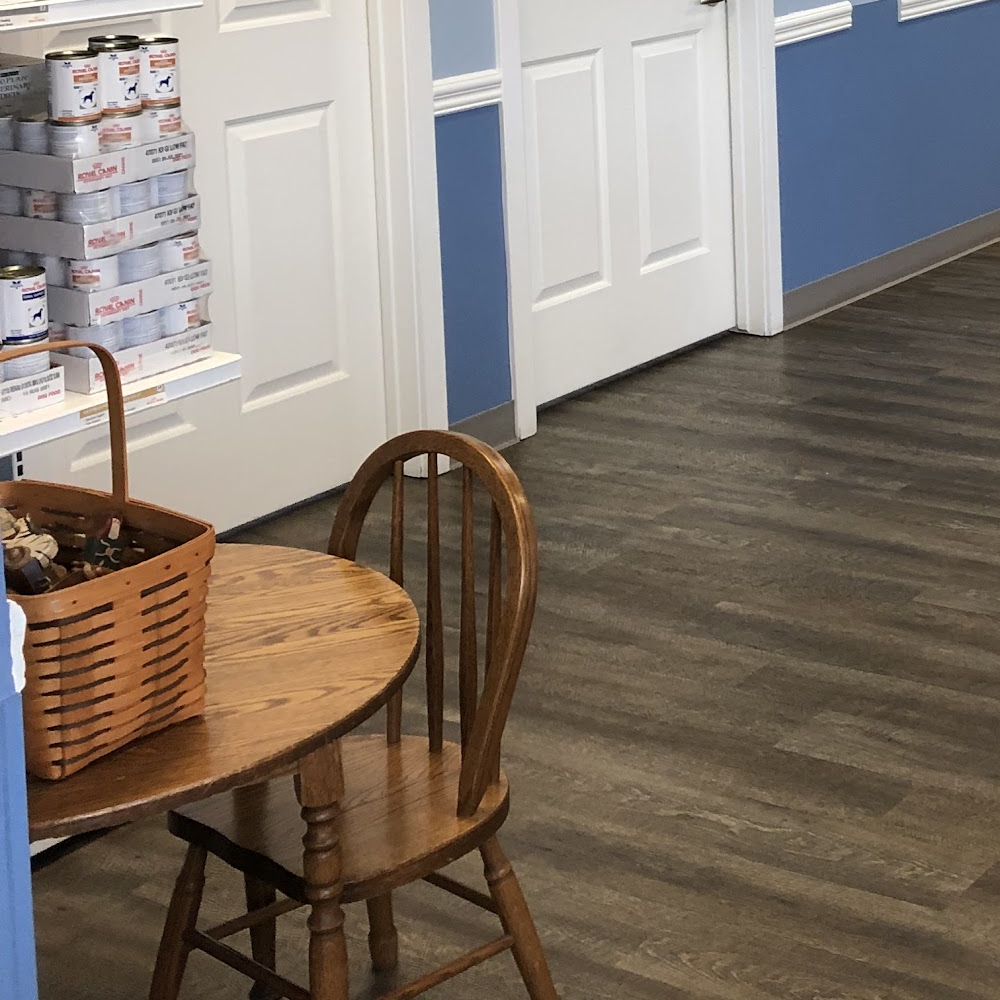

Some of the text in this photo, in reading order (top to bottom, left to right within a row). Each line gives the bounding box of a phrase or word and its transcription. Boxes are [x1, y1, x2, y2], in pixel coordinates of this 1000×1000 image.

[78, 165, 117, 179] ROYAL CANIN
[95, 297, 135, 314] ROYAL CANIN
